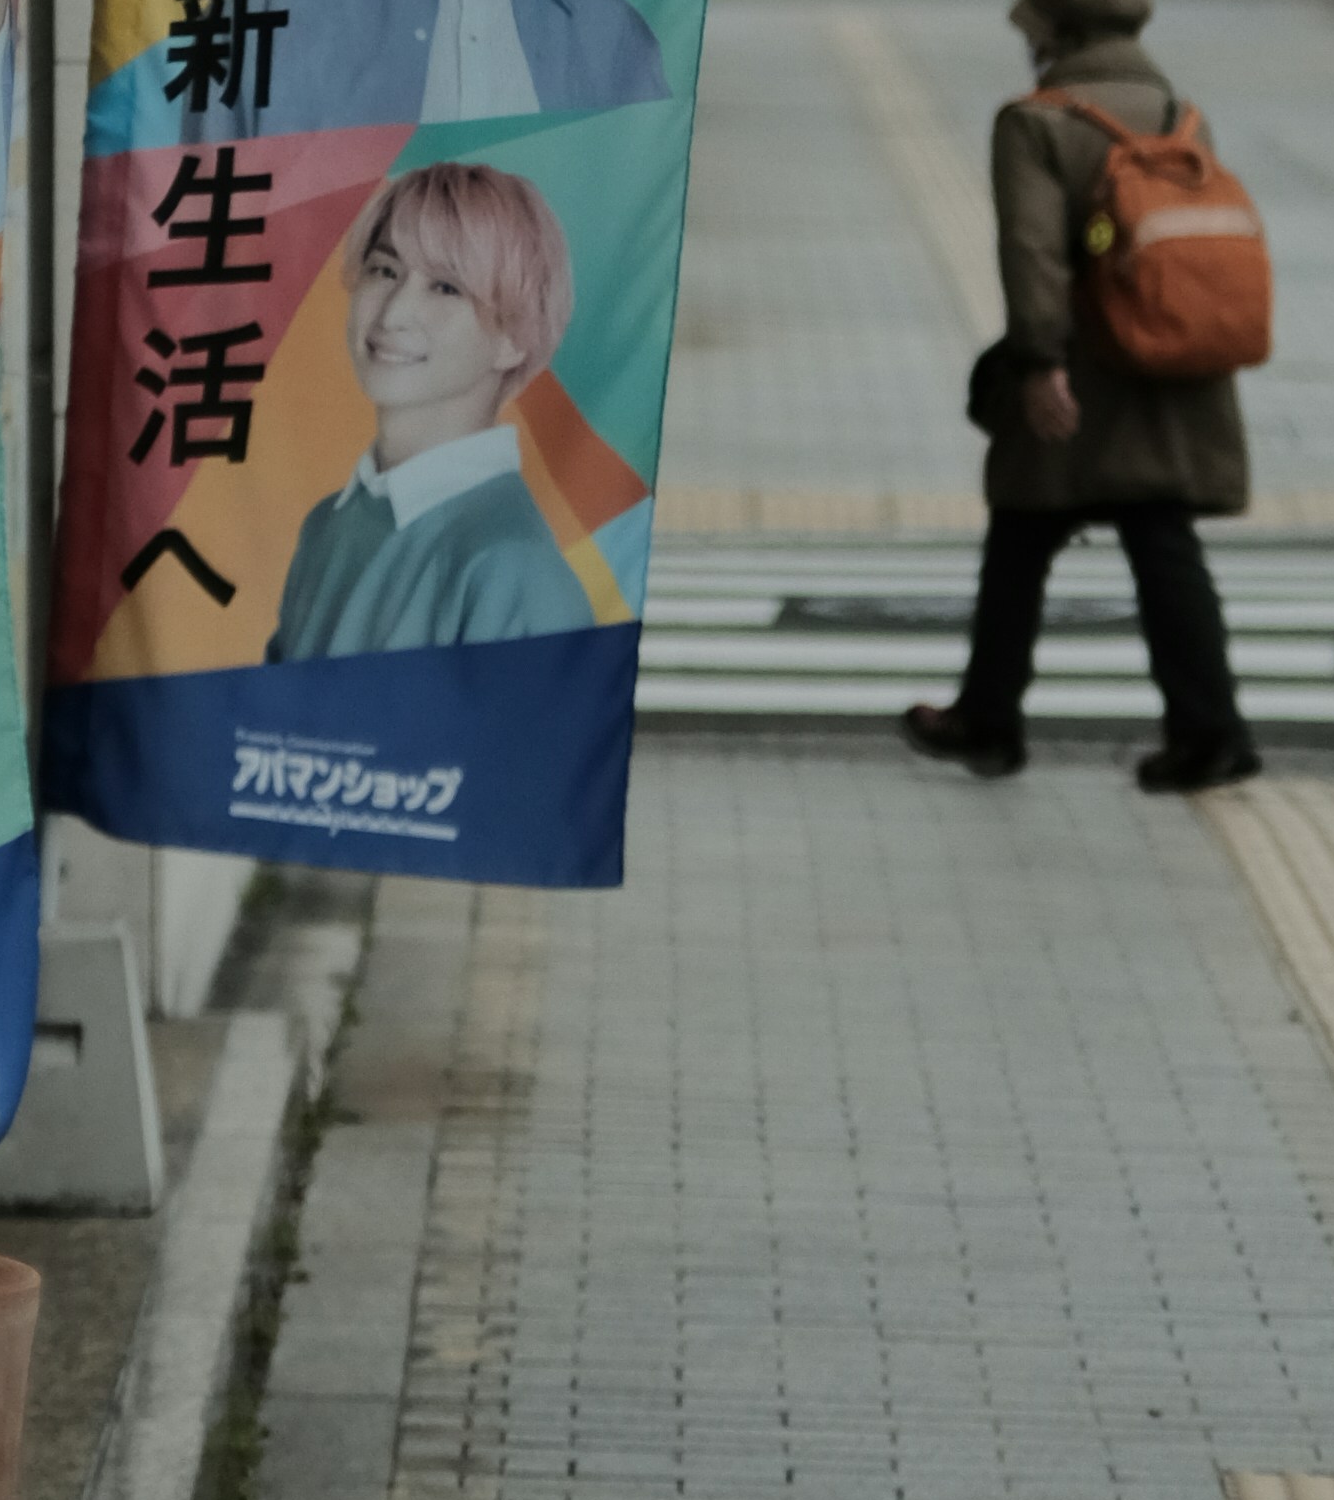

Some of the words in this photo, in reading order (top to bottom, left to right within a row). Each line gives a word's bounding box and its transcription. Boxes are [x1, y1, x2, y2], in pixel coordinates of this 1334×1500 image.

[230, 746, 464, 816] アパマンショップ
